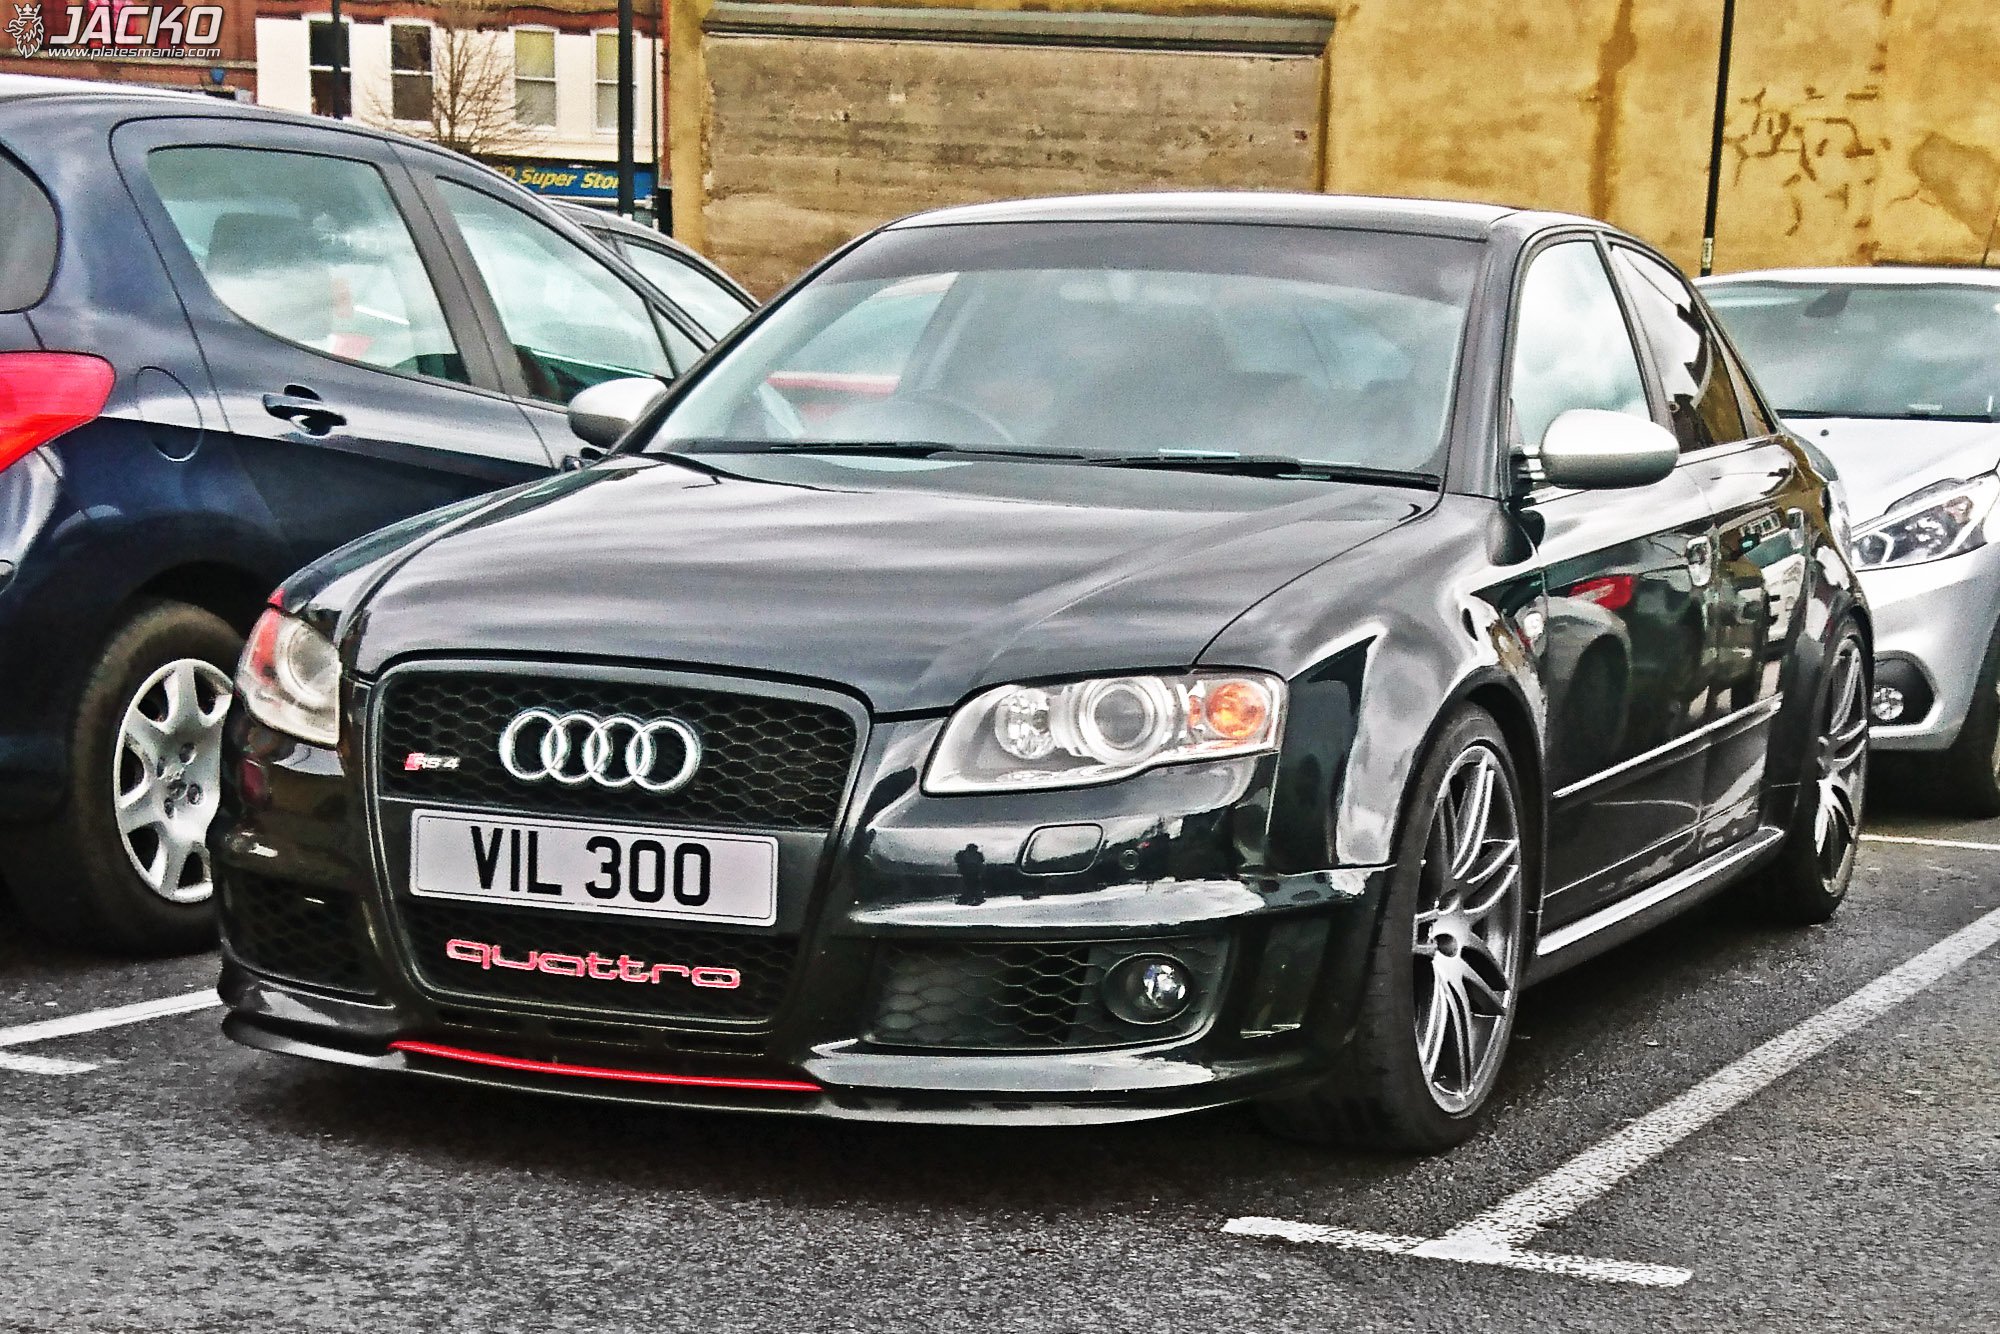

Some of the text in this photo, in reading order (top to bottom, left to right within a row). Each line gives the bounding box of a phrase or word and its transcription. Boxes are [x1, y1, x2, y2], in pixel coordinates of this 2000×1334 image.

[518, 166, 577, 188] Super
[470, 826, 711, 906] VIL 300
[446, 938, 741, 989] quattro
